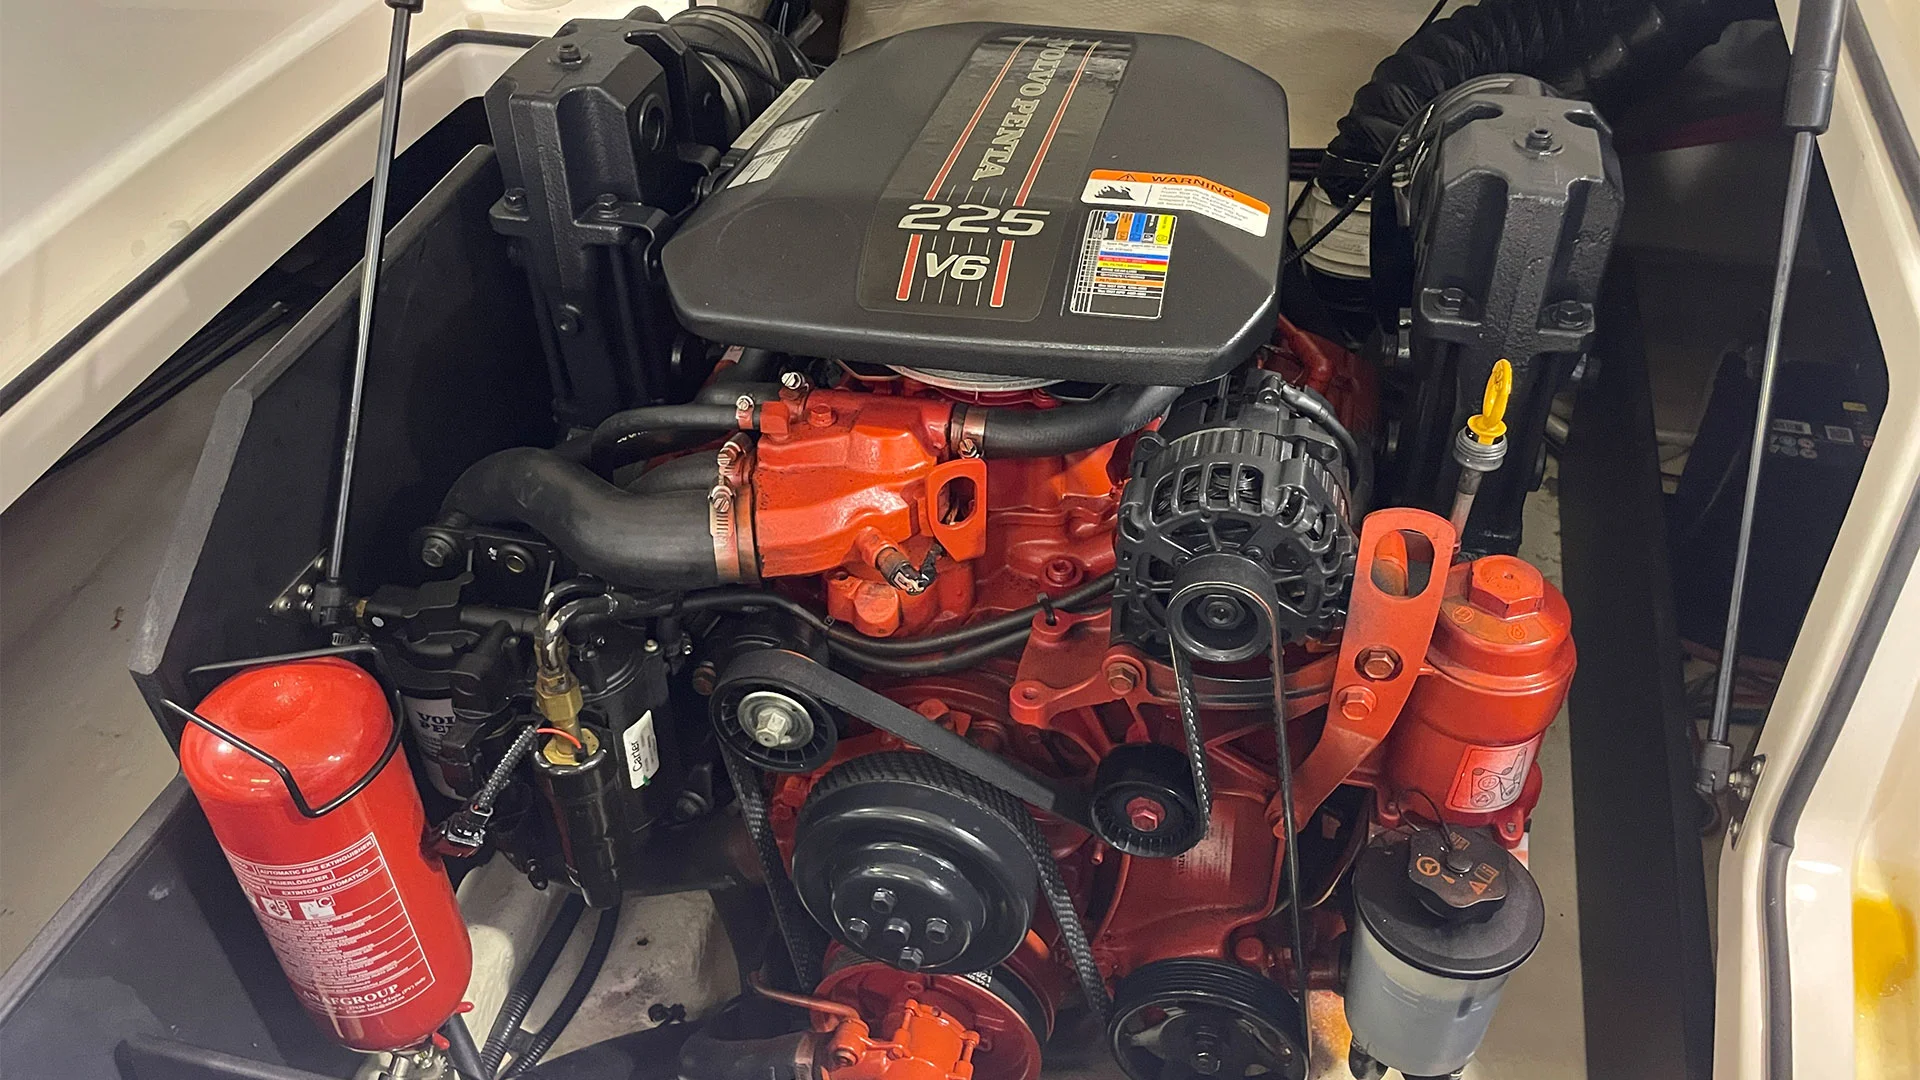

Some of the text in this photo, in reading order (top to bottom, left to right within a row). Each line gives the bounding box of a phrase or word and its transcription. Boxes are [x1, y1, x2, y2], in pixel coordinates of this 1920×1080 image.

[971, 40, 1075, 182] VOLVO PENTA
[1151, 176, 1235, 198] WARNING
[898, 203, 1051, 236] 225
[926, 252, 991, 281] V6
[631, 740, 643, 772] Carter
[260, 840, 373, 876] AUTOMATIC FIRE EXTINGUISHER
[281, 868, 369, 896] EXTINTOR AUTOMATICO
